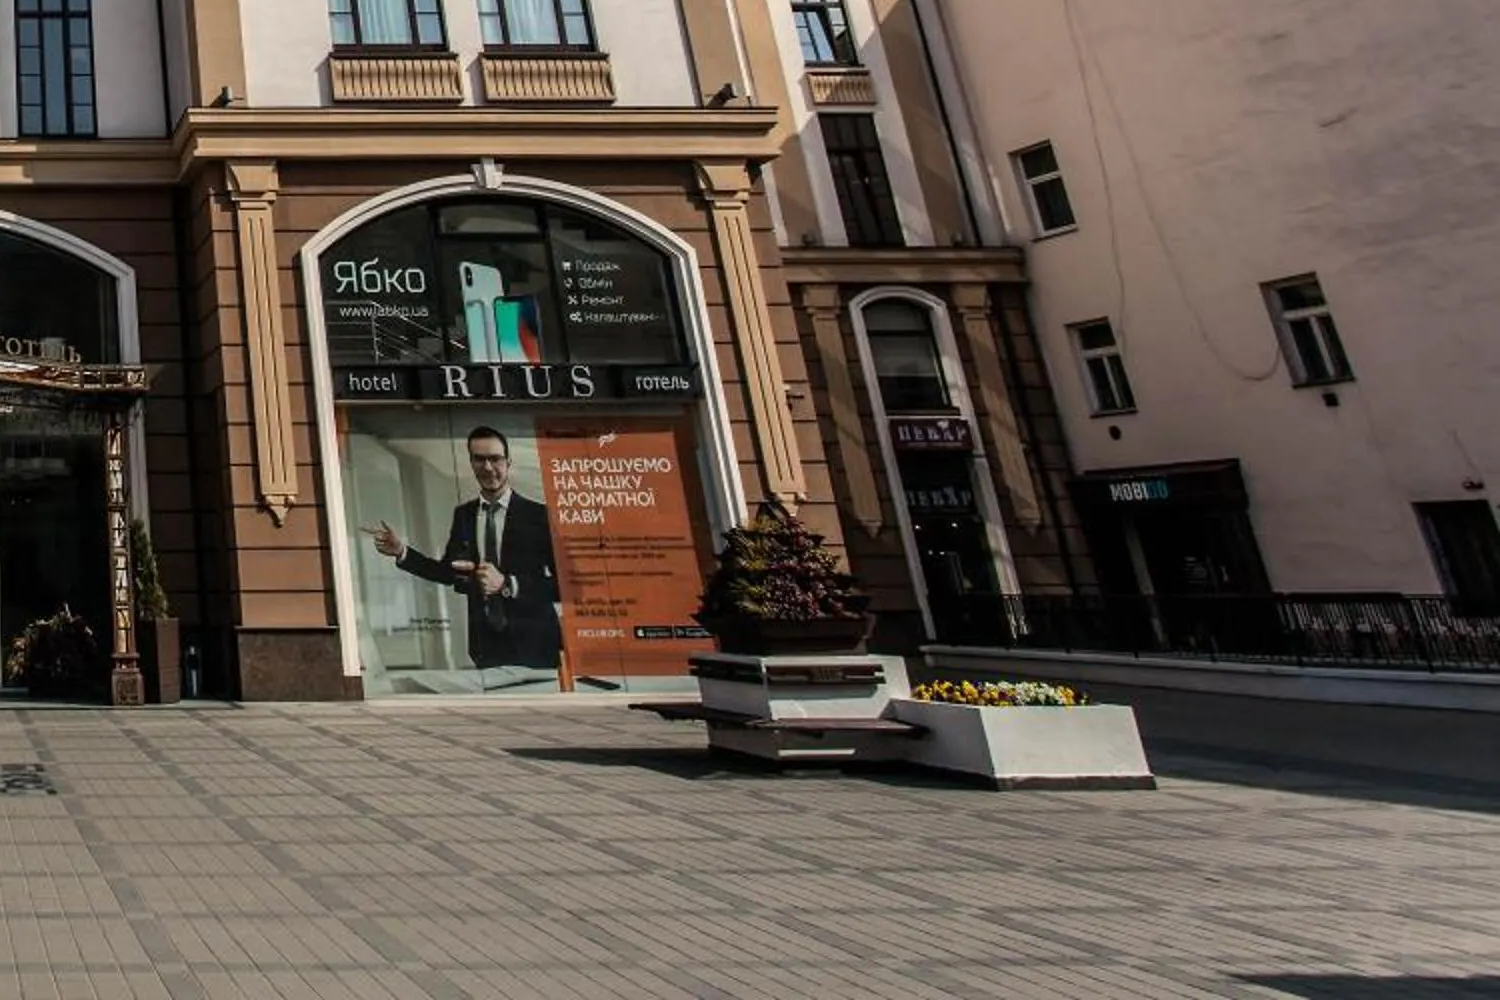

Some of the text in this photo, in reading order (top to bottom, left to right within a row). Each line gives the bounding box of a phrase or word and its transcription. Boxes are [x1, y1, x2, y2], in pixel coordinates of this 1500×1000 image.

[333, 257, 426, 293] Ябко
[349, 364, 690, 398] hotel RIUS готель
[551, 457, 671, 473] ЗАПРОШУЄМО
[553, 474, 643, 490] НА ЧАШКУ
[557, 488, 656, 508] АРОМАТНОЇ
[559, 508, 605, 525] КАВИ
